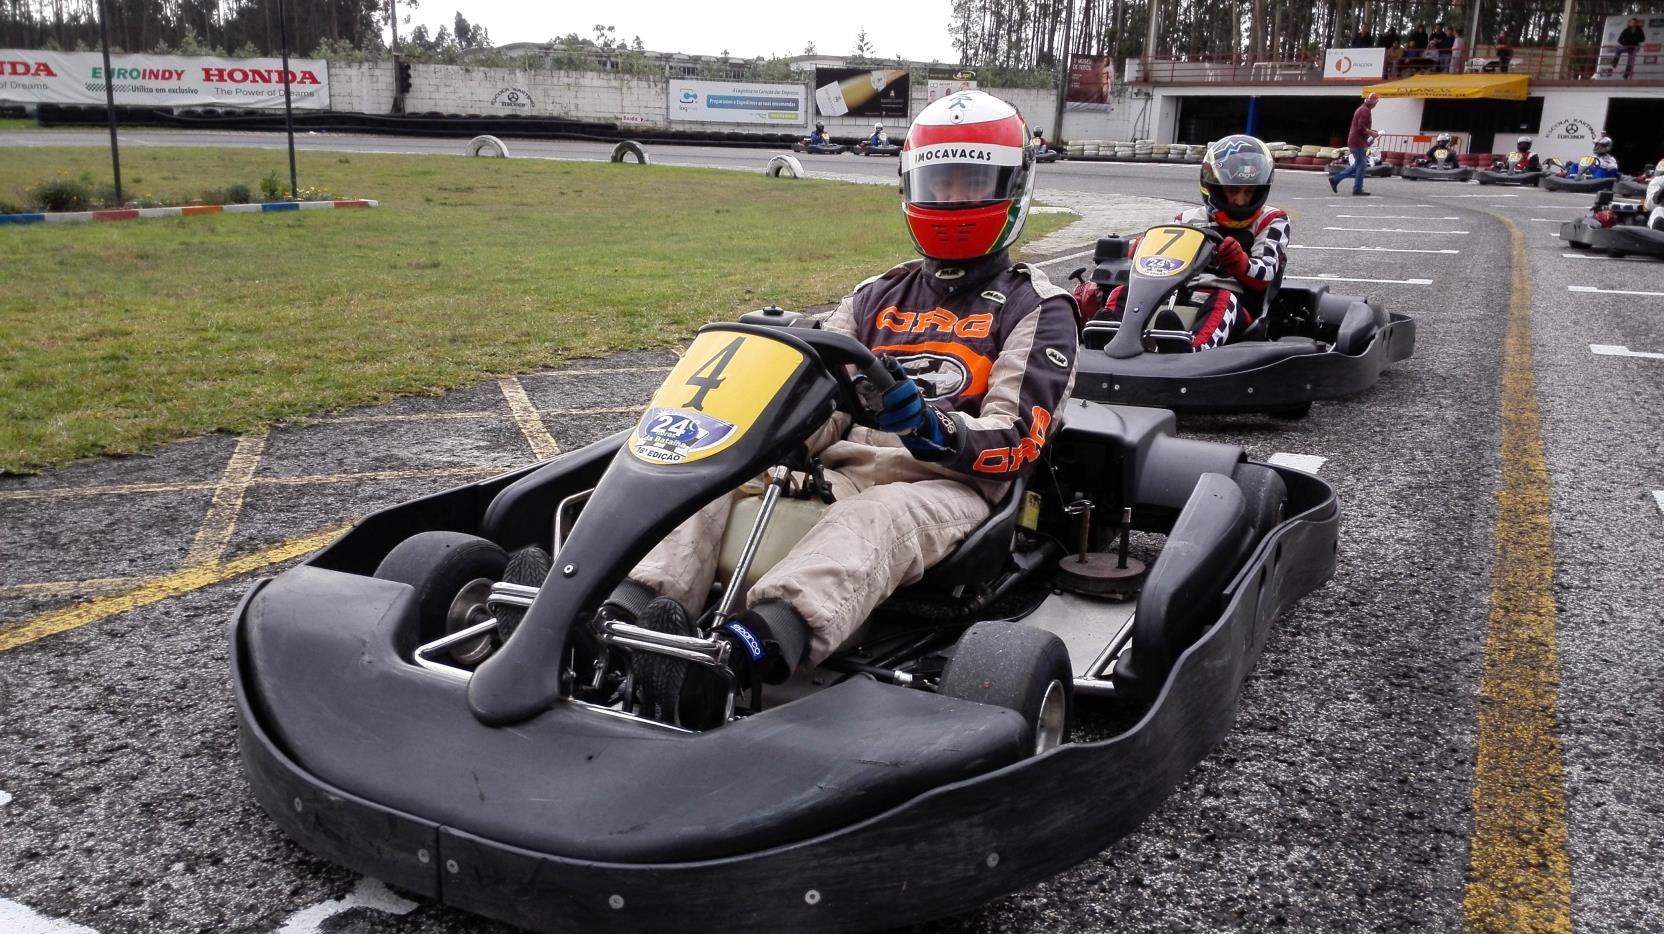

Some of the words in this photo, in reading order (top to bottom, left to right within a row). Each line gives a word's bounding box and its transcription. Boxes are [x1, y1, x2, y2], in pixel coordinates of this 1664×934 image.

[201, 68, 321, 84] HONDA
[10, 82, 48, 90] Dreams
[131, 85, 154, 93] Utiliza
[168, 86, 199, 95] exclusivo
[215, 88, 233, 96] The
[235, 88, 264, 97] Power
[267, 89, 276, 97] of
[279, 89, 315, 97] Deams
[914, 148, 992, 164] IMOCAVACAS
[1154, 229, 1185, 255] 7
[876, 306, 993, 338] CRG
[681, 336, 747, 412] 4
[650, 415, 690, 436] 24
[654, 435, 687, 449] Batalha
[729, 623, 761, 657] sparco
